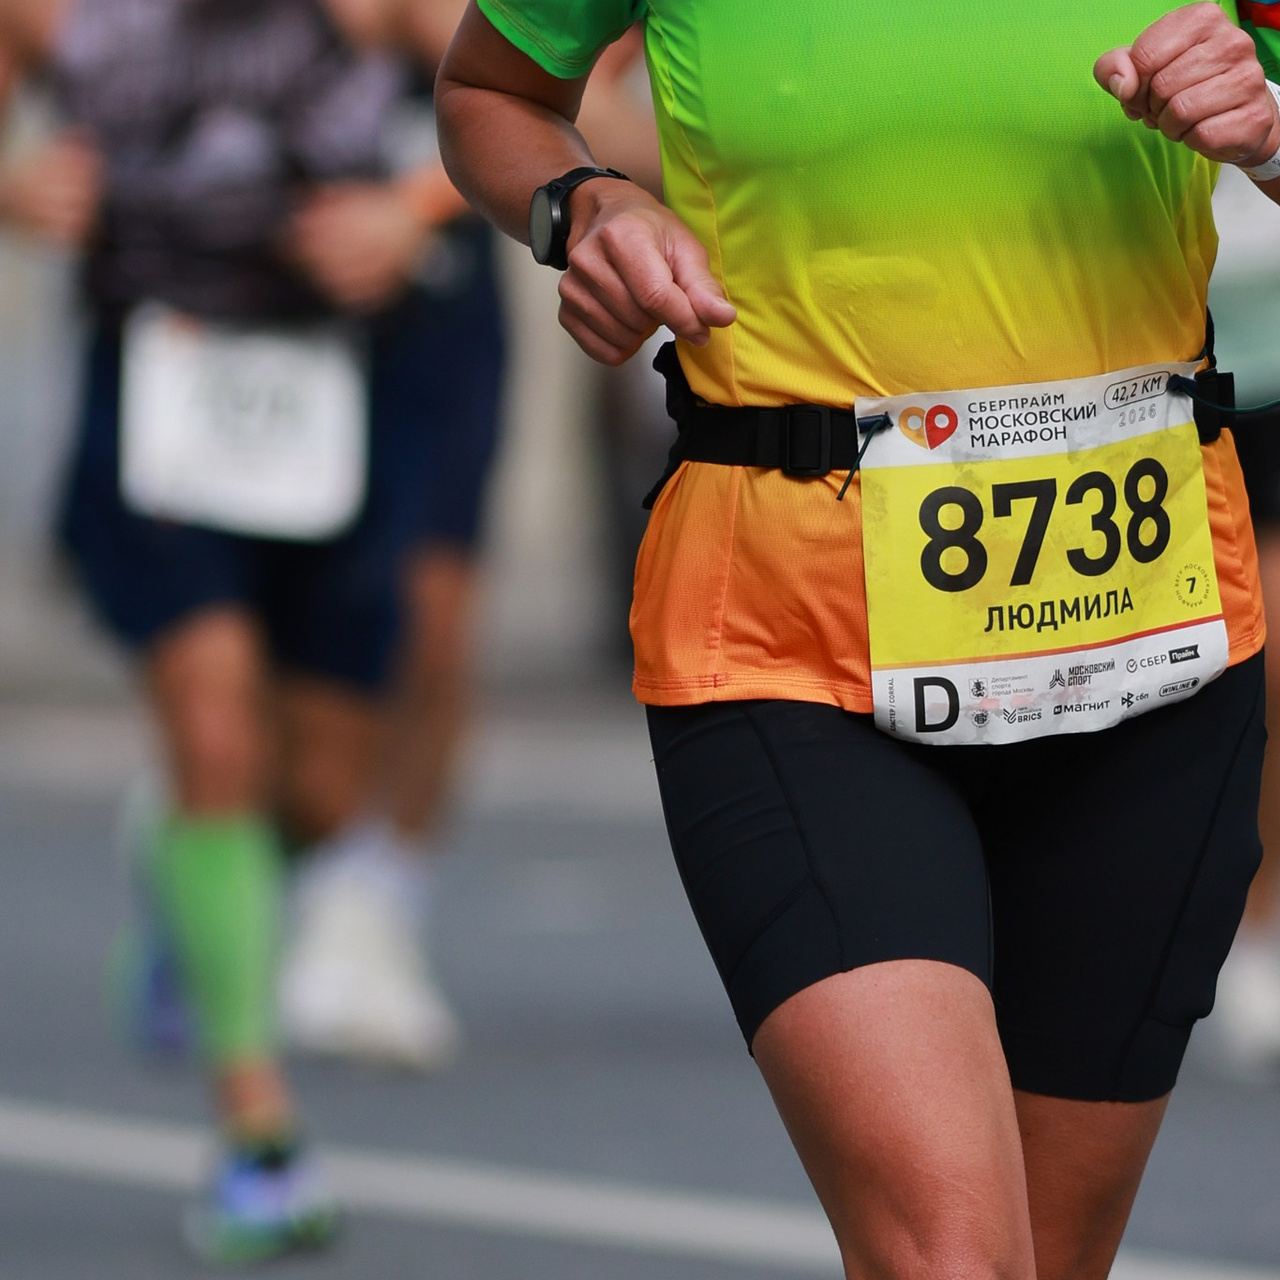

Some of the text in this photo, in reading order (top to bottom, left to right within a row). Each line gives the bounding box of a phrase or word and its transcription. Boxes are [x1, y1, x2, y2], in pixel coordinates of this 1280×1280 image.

[967, 393, 1065, 414] СБЕРПРАЙМ
[1112, 383, 1138, 403] 42,2
[969, 402, 1097, 431] МОСКОВСКИЙ
[1118, 403, 1157, 427] 2026
[970, 426, 1067, 448] МАРАФОН
[918, 457, 1171, 593] 8738
[1186, 576, 1196, 594] 7
[984, 587, 1134, 632] ЛЮДМИЛА
[1068, 658, 1116, 676] МОСКОВСКИЙ
[1139, 654, 1167, 668] СБЕР
[1068, 675, 1092, 687] СПОРТ
[913, 676, 960, 733] D
[1017, 712, 1042, 723] BRICS
